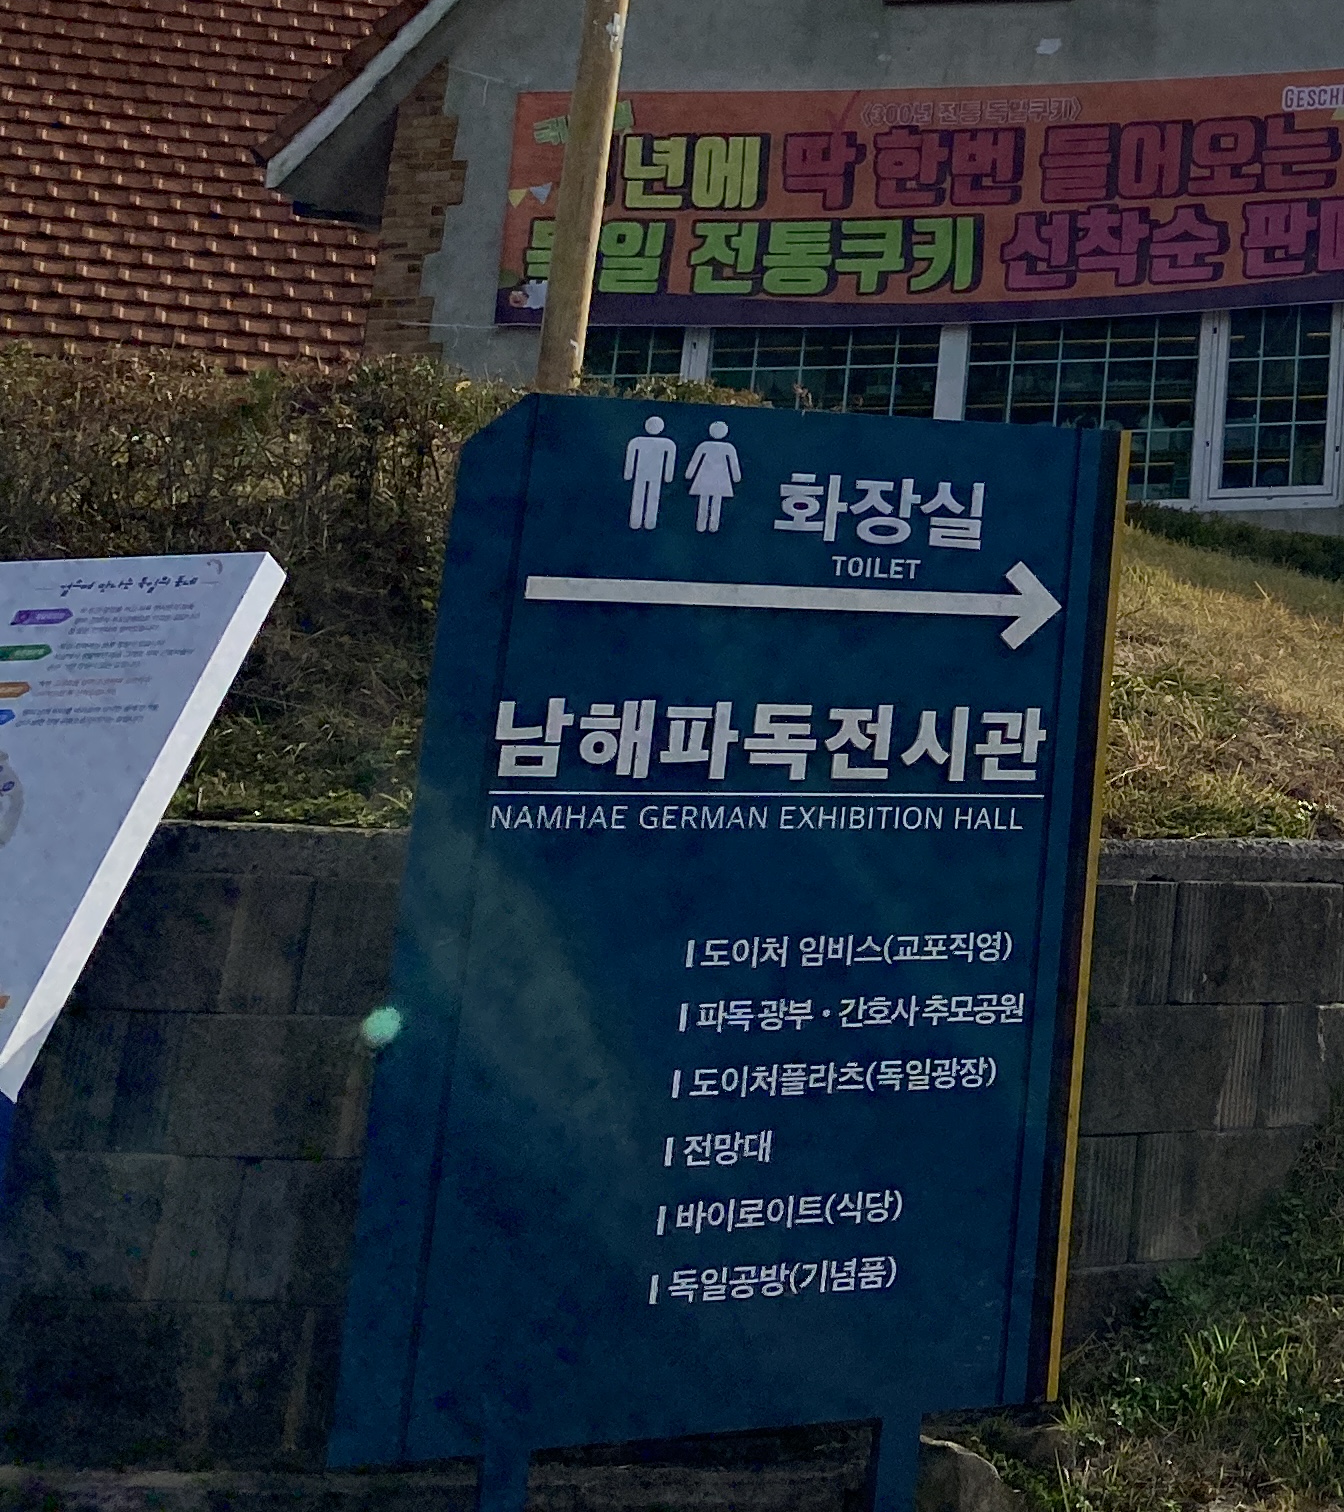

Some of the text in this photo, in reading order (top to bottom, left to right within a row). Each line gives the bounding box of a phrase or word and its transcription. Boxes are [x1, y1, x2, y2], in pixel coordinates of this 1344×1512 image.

[939, 100, 983, 124] 전통
[608, 112, 1342, 210] 년에 딱 한번 들어오는
[691, 217, 982, 295] 전통쿠키
[1002, 203, 1230, 292] 선착순
[773, 473, 986, 550] 화장실
[831, 555, 921, 580] TOILET
[493, 697, 1048, 782] 남해파독전시관
[490, 805, 1024, 831] NAMHAE GERMAN EXHIBITION HALL
[700, 936, 790, 969] 도이처
[689, 1056, 998, 1099] 도이처플라츠(독일광장)
[683, 1129, 773, 1167] 전망대
[675, 1190, 903, 1234] 바이로이트(식당)
[668, 1255, 897, 1304] 독일공방(기념품)
